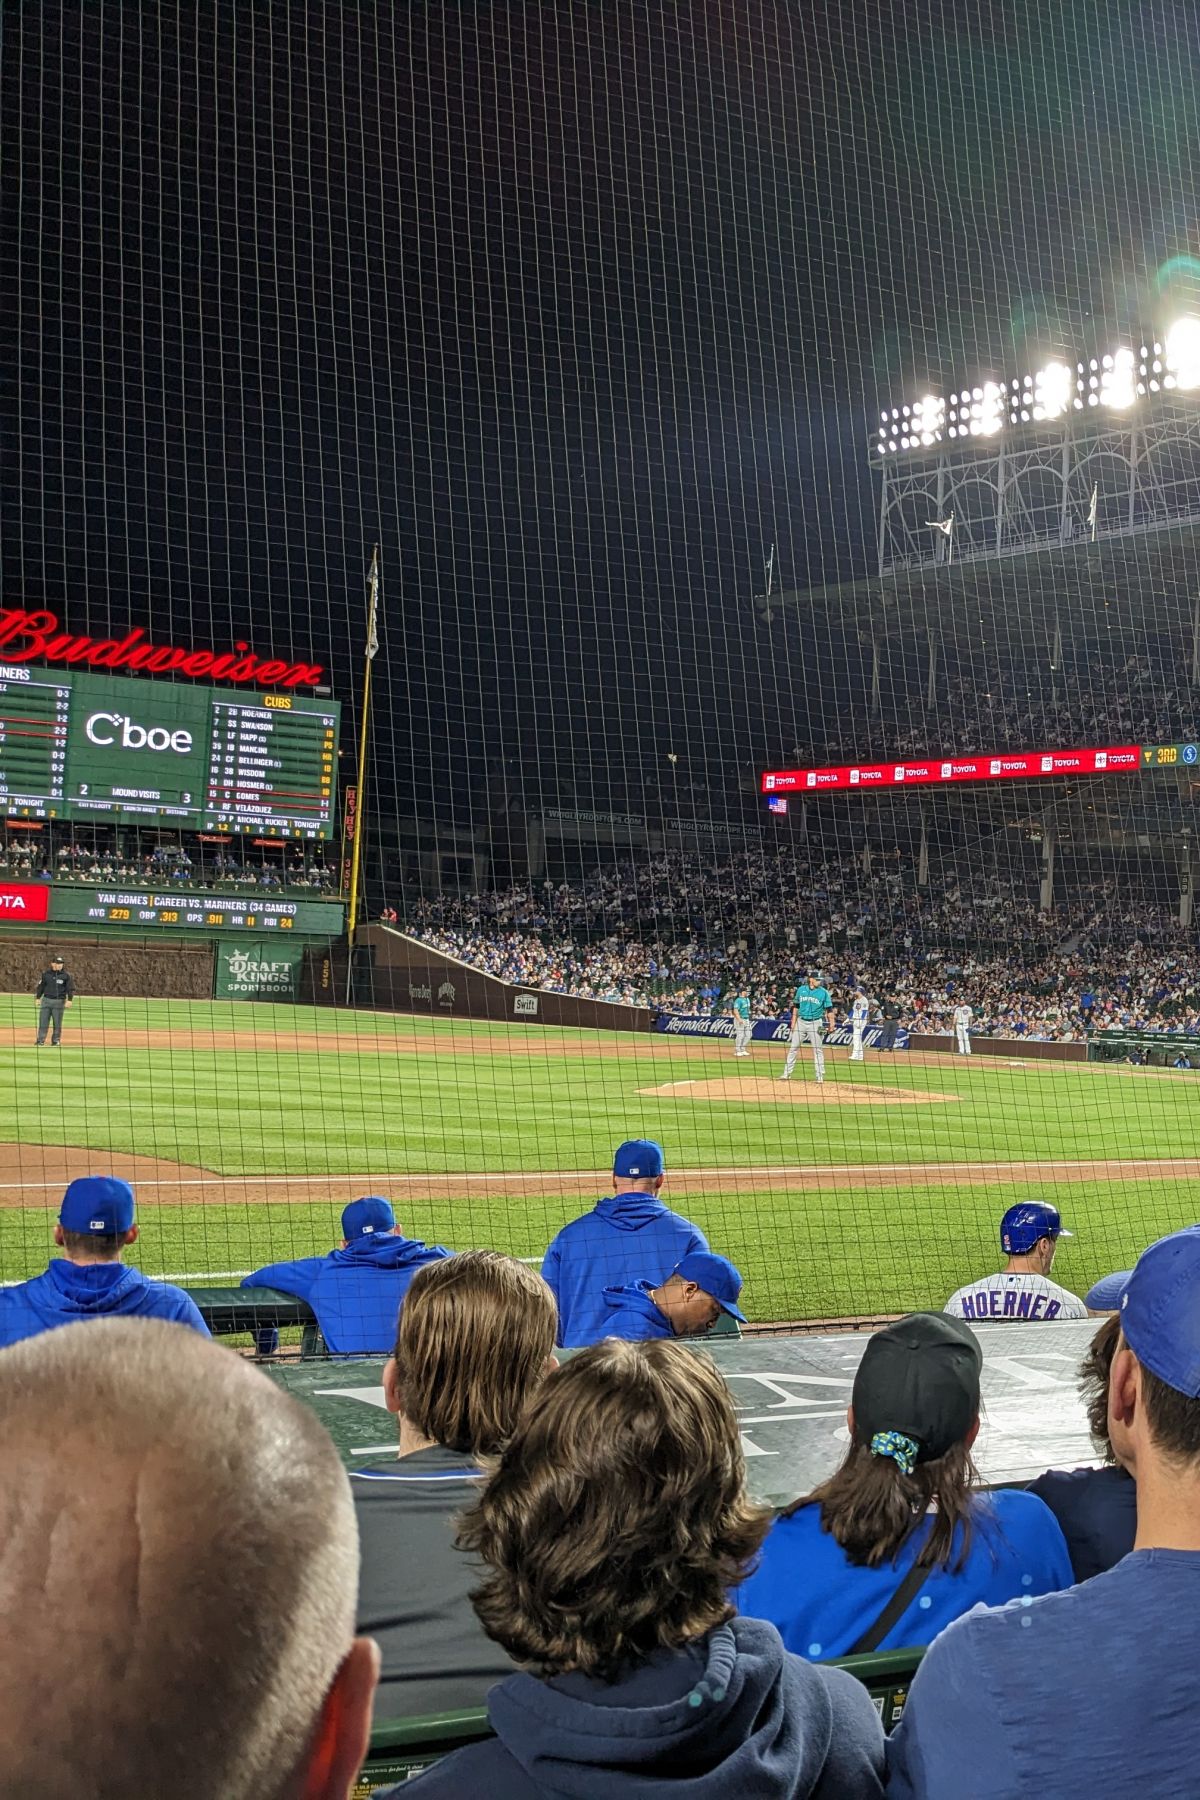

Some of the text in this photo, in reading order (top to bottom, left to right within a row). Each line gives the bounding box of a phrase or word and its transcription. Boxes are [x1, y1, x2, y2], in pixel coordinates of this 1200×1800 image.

[0, 608, 324, 686] Budweiser
[57, 690, 69, 698] 0-3
[56, 702, 69, 710] 2-2
[264, 696, 291, 708] CUBS
[214, 706, 220, 714] 2
[323, 718, 334, 726] 0-2
[54, 727, 67, 735] 2-2
[228, 720, 237, 728] SS
[241, 721, 273, 731] SWANSON
[86, 713, 193, 752] Cboe
[227, 731, 236, 740] LF
[240, 733, 257, 742] HAPP
[52, 751, 65, 759] 0-0
[240, 745, 268, 754] MANCINI
[225, 755, 234, 763] CF
[239, 757, 273, 767] BELLINGER
[1109, 755, 1135, 763] TOYOTA
[1157, 748, 1177, 764] 3RD
[52, 764, 64, 772] 0-2
[1002, 762, 1027, 770] TOYOTA
[1055, 759, 1080, 767] TOYOTA
[238, 768, 265, 778] WISDOM
[906, 768, 928, 777] TOYOTA
[223, 779, 233, 787] DH
[237, 780, 264, 790] HOSMER
[51, 788, 63, 796] 0-1
[80, 784, 191, 803] 2 MOUND VISITS 3
[225, 791, 230, 799] C
[236, 792, 260, 801] GOMES
[15, 798, 44, 807] TONIGHT
[222, 803, 231, 811] RF
[237, 816, 264, 825] MICHAEL
[265, 818, 287, 827] RUCKER
[294, 821, 320, 829] TONIGHT
[98, 894, 297, 915] YAN GOMES CAREER VS. MARINERS (34 GAMES)
[89, 908, 293, 928] AVG .279 OBP .313 OPS .911 HR 11 RBI 24
[229, 960, 292, 973] DRAFT
[236, 971, 290, 983] KINGS
[227, 983, 295, 993] SPORTSBOOK
[517, 999, 535, 1011] Swift
[665, 1017, 712, 1033] Reynolds
[825, 1028, 853, 1045] Wra
[1004, 1235, 1010, 1245] 2
[961, 1291, 1062, 1319] HOERNER
